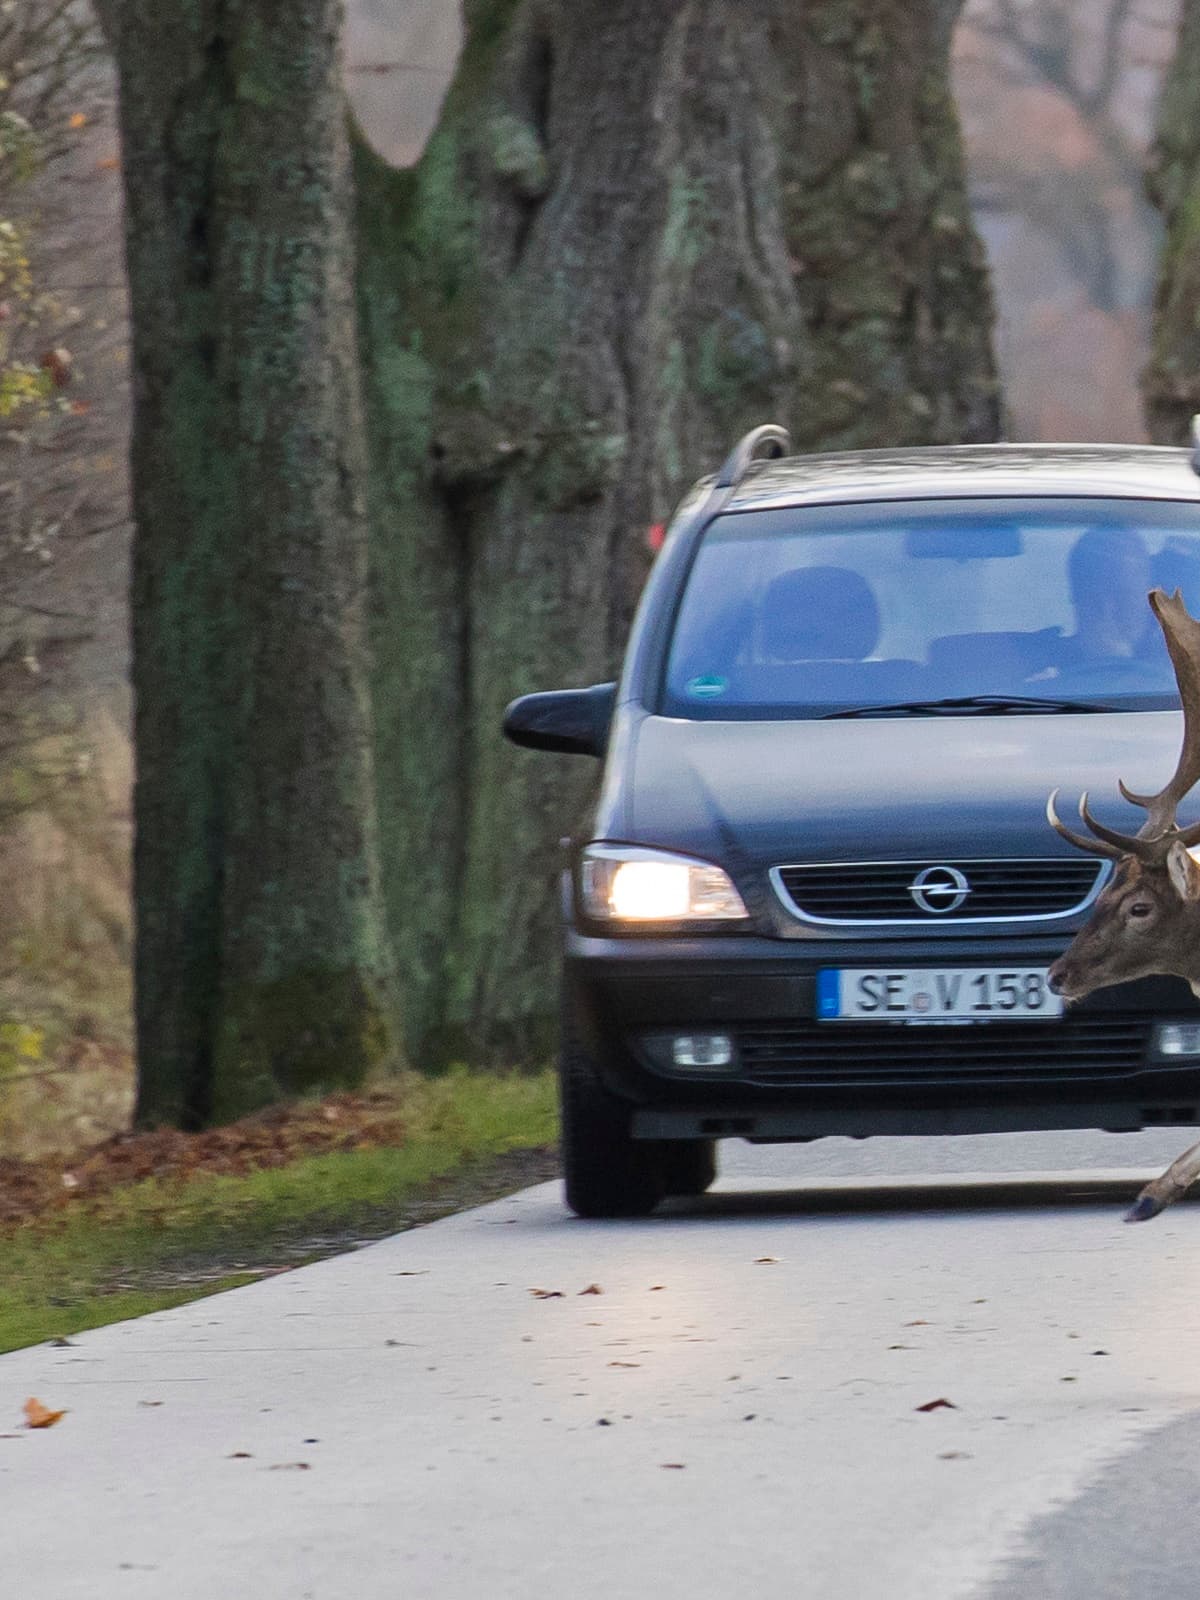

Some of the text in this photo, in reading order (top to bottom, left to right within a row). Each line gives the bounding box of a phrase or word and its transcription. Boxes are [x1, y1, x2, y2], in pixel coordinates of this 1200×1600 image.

[857, 973, 1045, 1011] SE V 158
